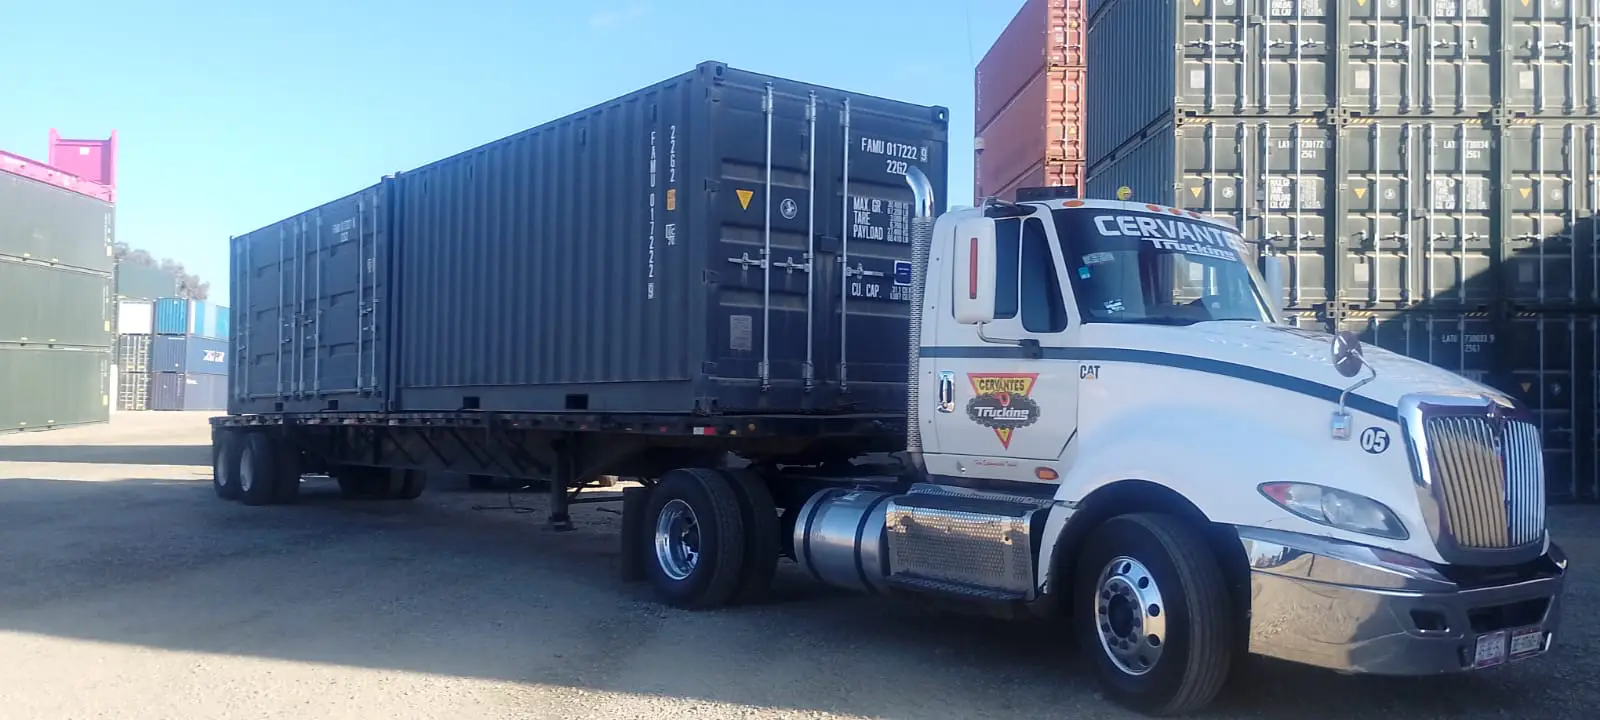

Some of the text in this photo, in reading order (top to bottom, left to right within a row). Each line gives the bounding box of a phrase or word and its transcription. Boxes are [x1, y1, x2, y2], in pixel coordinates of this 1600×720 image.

[861, 137, 928, 162] FAMU 017222 9
[886, 160, 908, 175] 22G2
[853, 211, 871, 225] TARE
[853, 224, 883, 240] PAYLOAD
[1094, 215, 1249, 255] CERVANTES
[1141, 237, 1237, 261] Trucking
[851, 282, 863, 297] CU.
[866, 283, 882, 298] CAP.
[1080, 365, 1100, 379] CAT
[979, 379, 1025, 391] CERVANTES
[974, 406, 1029, 420] Trucking
[1362, 429, 1386, 452] 05
